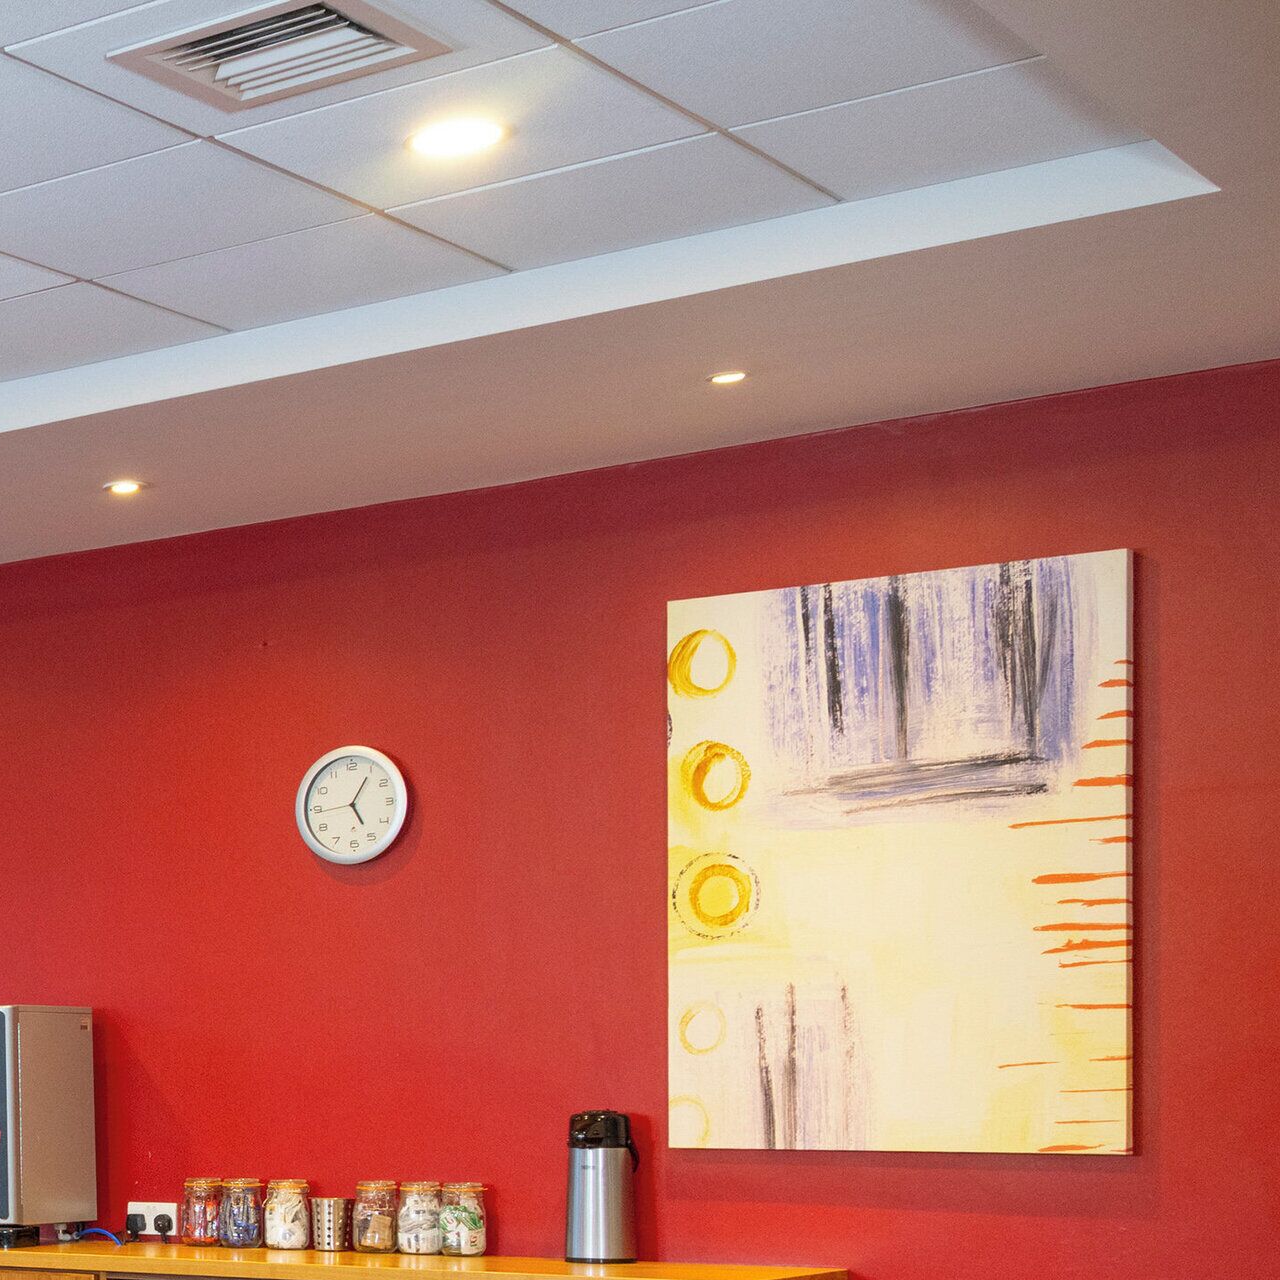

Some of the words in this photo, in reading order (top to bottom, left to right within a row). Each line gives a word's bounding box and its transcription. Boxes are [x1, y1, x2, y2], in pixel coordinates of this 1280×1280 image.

[346, 762, 358, 771] 12
[330, 771, 338, 779] 11
[379, 779, 389, 788] 2
[317, 786, 328, 796] 10
[385, 797, 394, 806] 3
[318, 823, 328, 832] 8
[332, 836, 341, 845] 7
[366, 832, 377, 841] 5
[350, 840, 359, 848] 6
